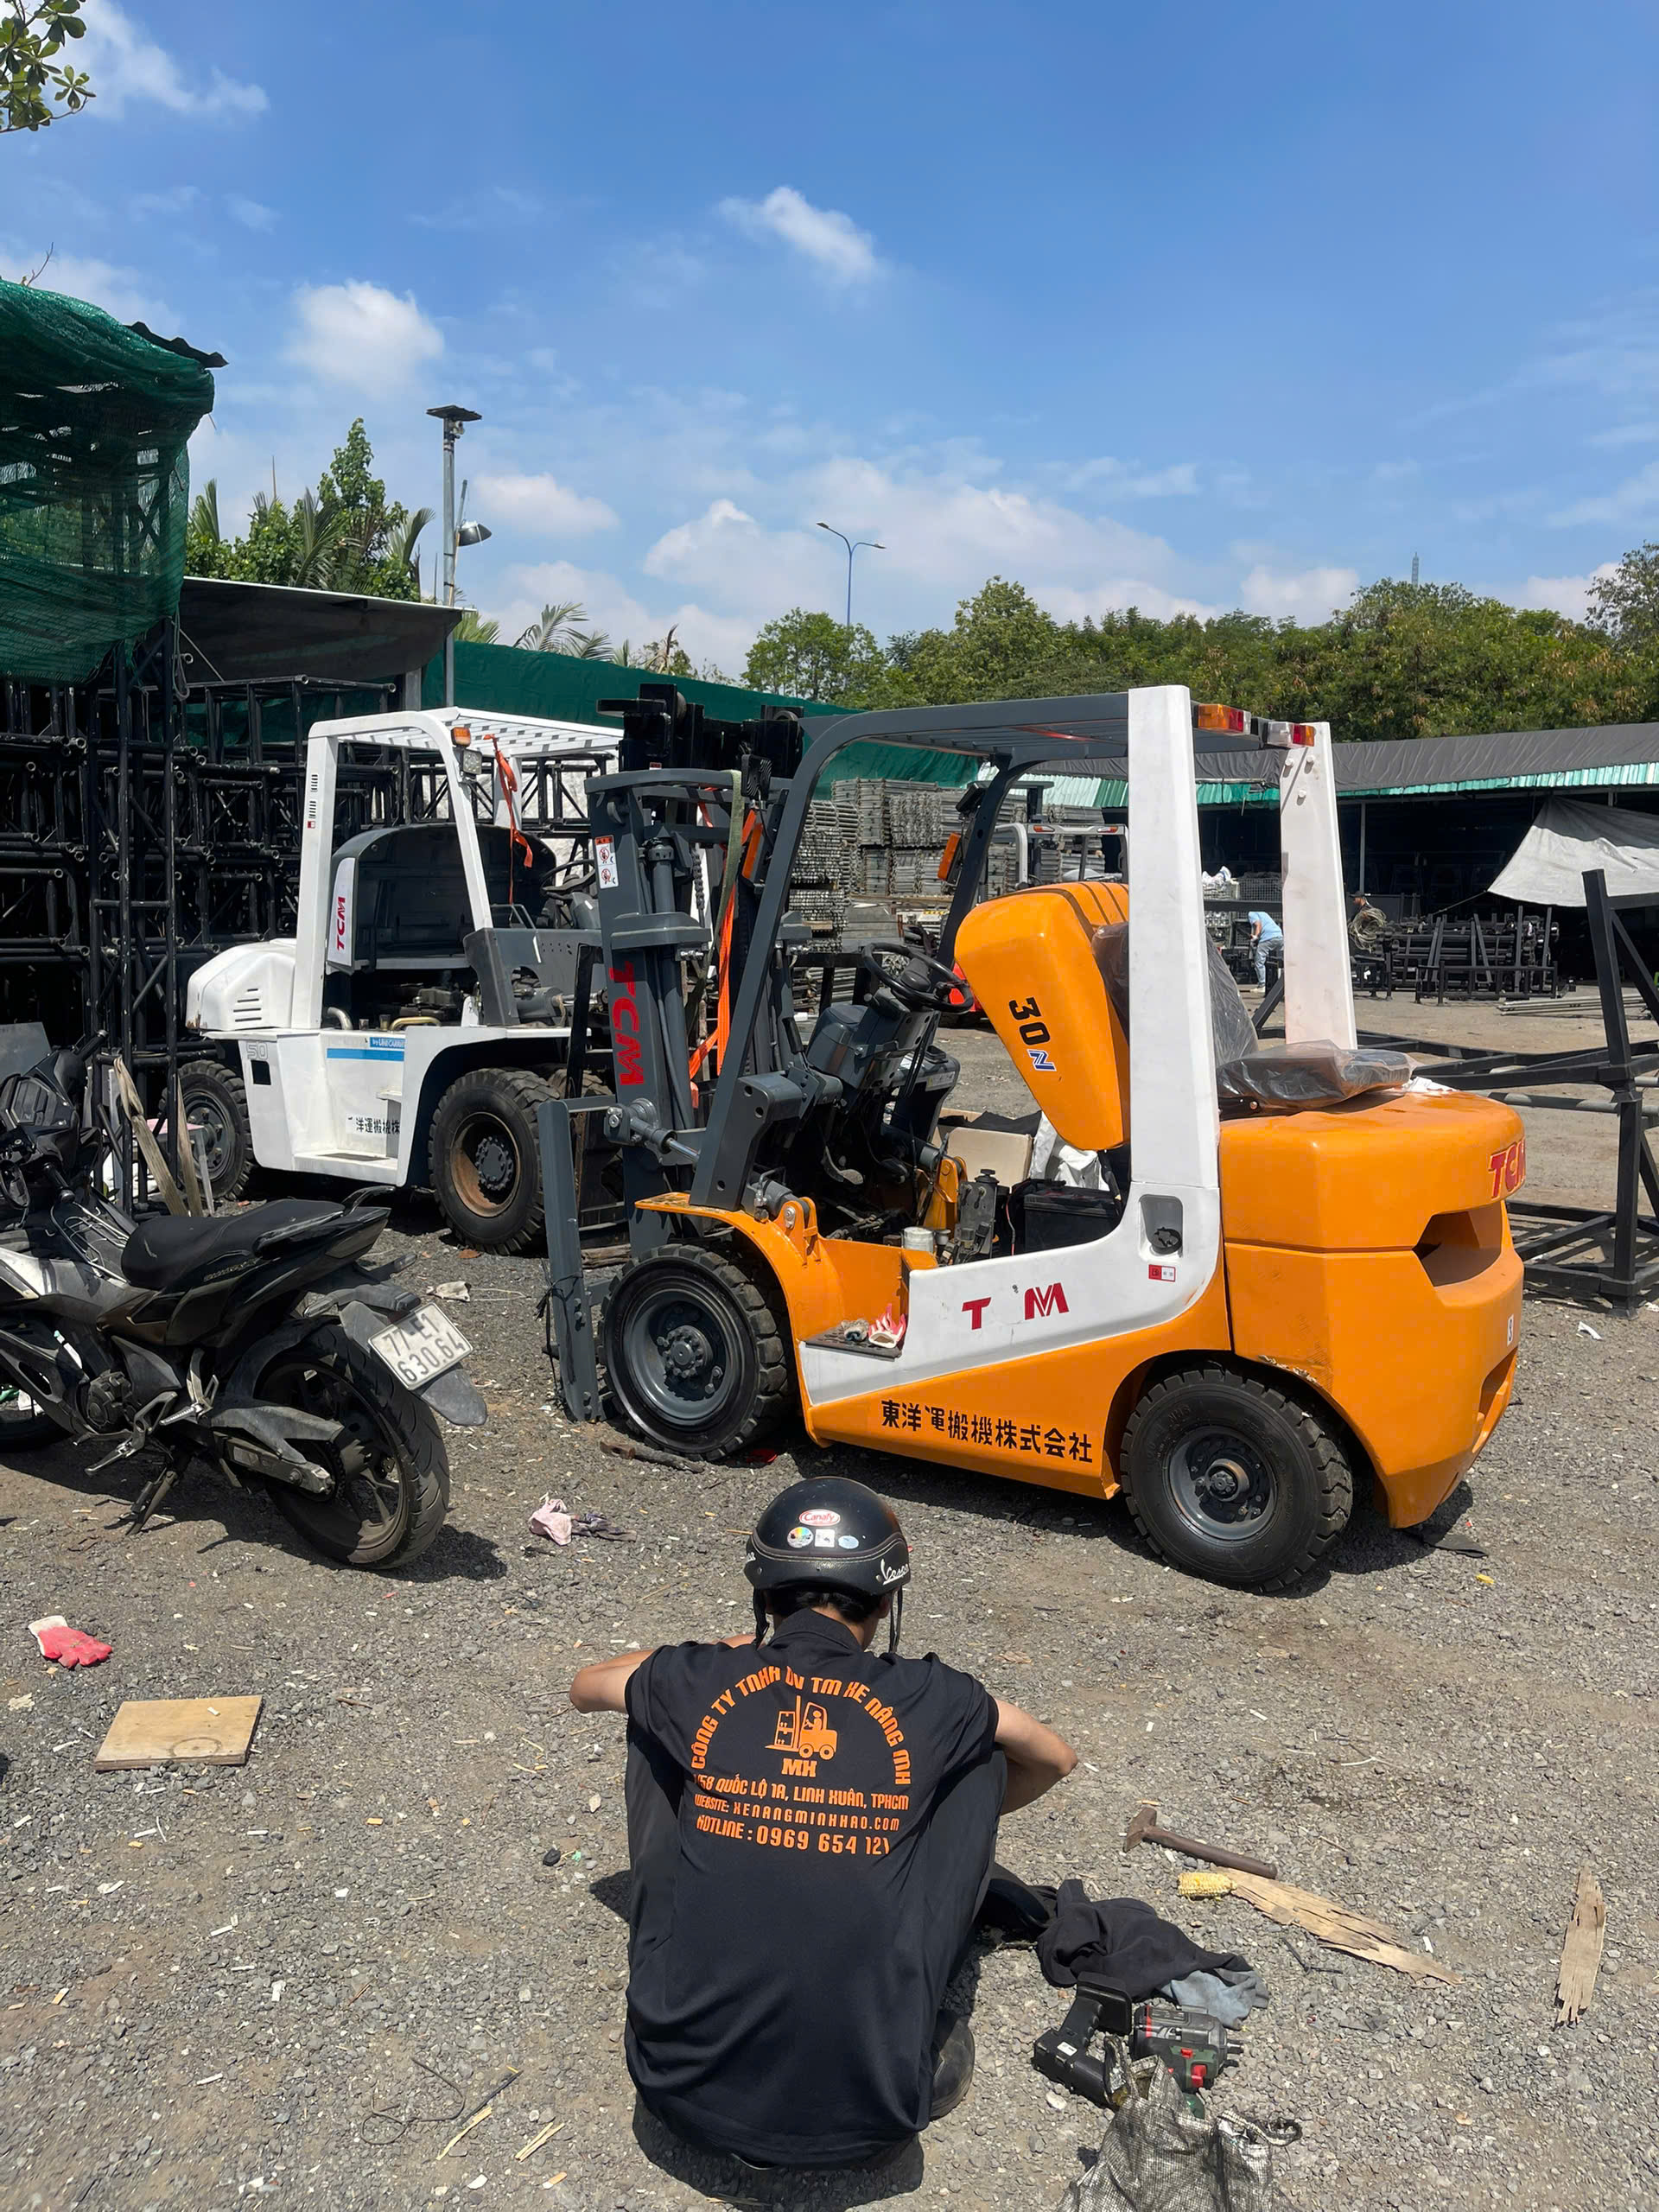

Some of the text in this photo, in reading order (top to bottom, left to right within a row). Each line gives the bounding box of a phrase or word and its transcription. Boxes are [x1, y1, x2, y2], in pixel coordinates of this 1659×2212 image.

[336, 896, 346, 950] TCM
[608, 960, 645, 1085] TCM
[246, 1042, 268, 1059] 50
[397, 1332, 467, 1382] 630.64
[691, 1665, 912, 1784] CÔNG TY TNHH DV TM XE NÂNG MH
[781, 1758, 817, 1777] MH
[715, 1773, 748, 1796] QUỐC
[750, 1778, 767, 1799] LỘ
[793, 1786, 825, 1803] LINH
[828, 1788, 868, 1809] XUÂN,
[870, 1793, 910, 1810] TPHCM
[695, 1794, 899, 1831] WEBSITE: XENANGMINHHAO.COM
[756, 1825, 810, 1851] 0969
[817, 1833, 858, 1854] 654
